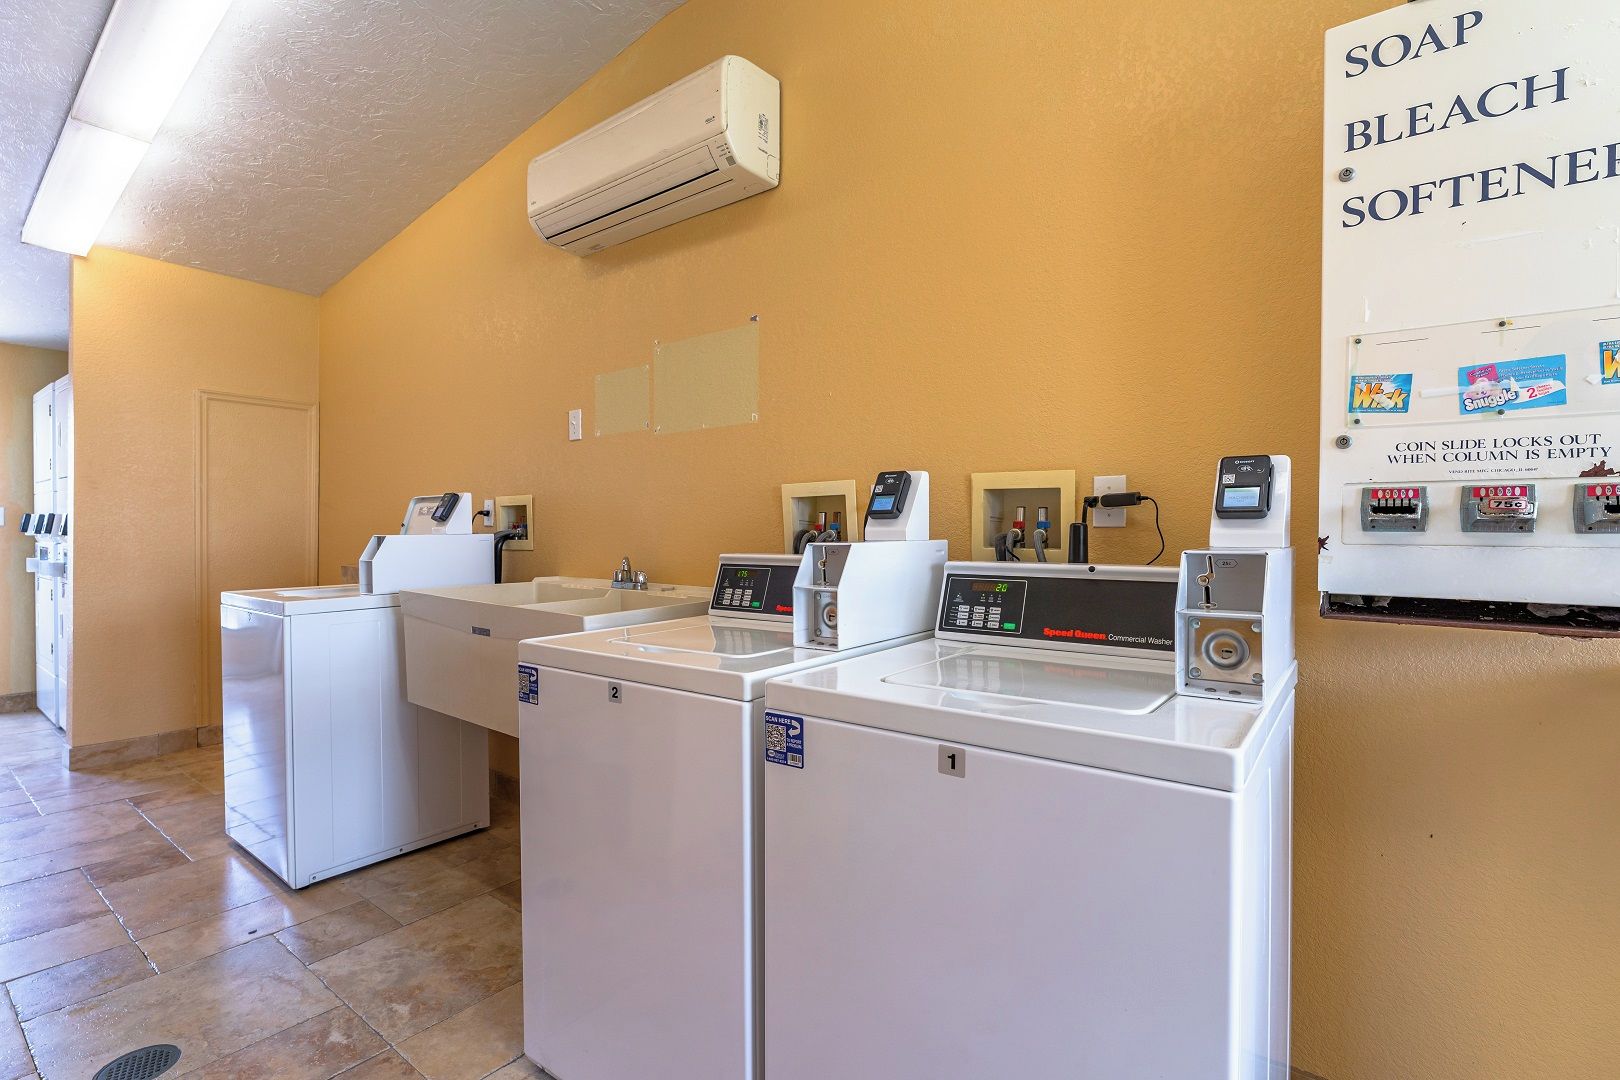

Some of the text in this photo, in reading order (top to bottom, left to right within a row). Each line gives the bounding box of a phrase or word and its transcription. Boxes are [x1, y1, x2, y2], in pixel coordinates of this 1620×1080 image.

[1345, 10, 1483, 78] SOAP
[1344, 66, 1570, 153] BLEACH
[1352, 382, 1409, 408] Wik
[1464, 388, 1518, 411] Snuggle
[1526, 387, 1537, 399] 2
[1395, 433, 1602, 452] COIN SLIDE LOCKS OUT
[1387, 446, 1612, 465] WHEN COLUMN IS EMPTY
[1043, 627, 1173, 646] Speed Queen Commercial Washer
[611, 686, 619, 698] 2
[765, 715, 791, 725] SCAN HERE
[947, 753, 956, 770] 1
